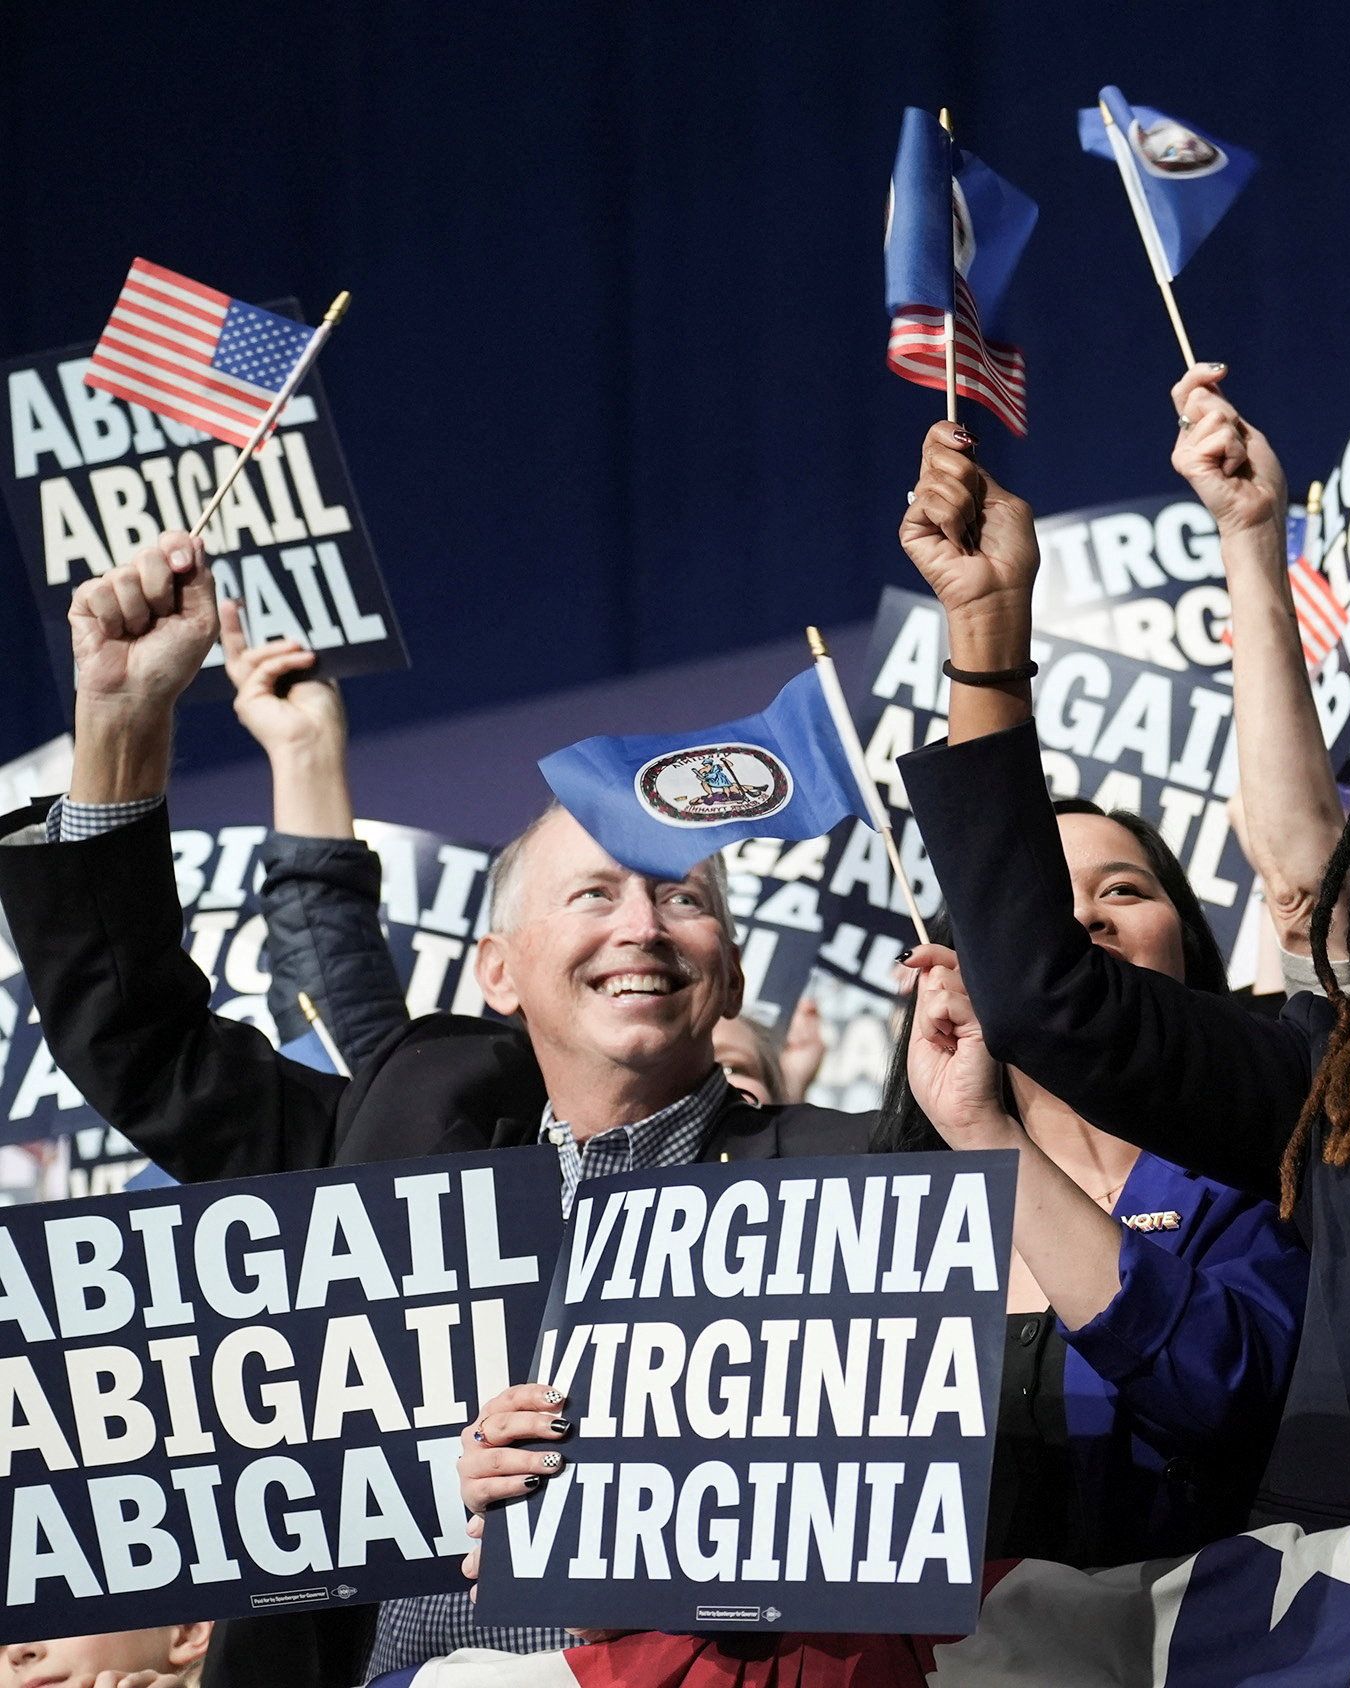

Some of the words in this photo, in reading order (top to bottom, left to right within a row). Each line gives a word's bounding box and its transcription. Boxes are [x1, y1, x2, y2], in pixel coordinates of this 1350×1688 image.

[40, 431, 351, 585] ABIGAIL
[0, 1168, 539, 1343] ABIGAIL
[565, 1173, 998, 1304] VIRGINIA
[1121, 1211, 1180, 1231] VOTE
[537, 1317, 986, 1438] VIRGINIA
[6, 1436, 481, 1606] ABIGAI
[505, 1461, 973, 1584] VIRGINIA
